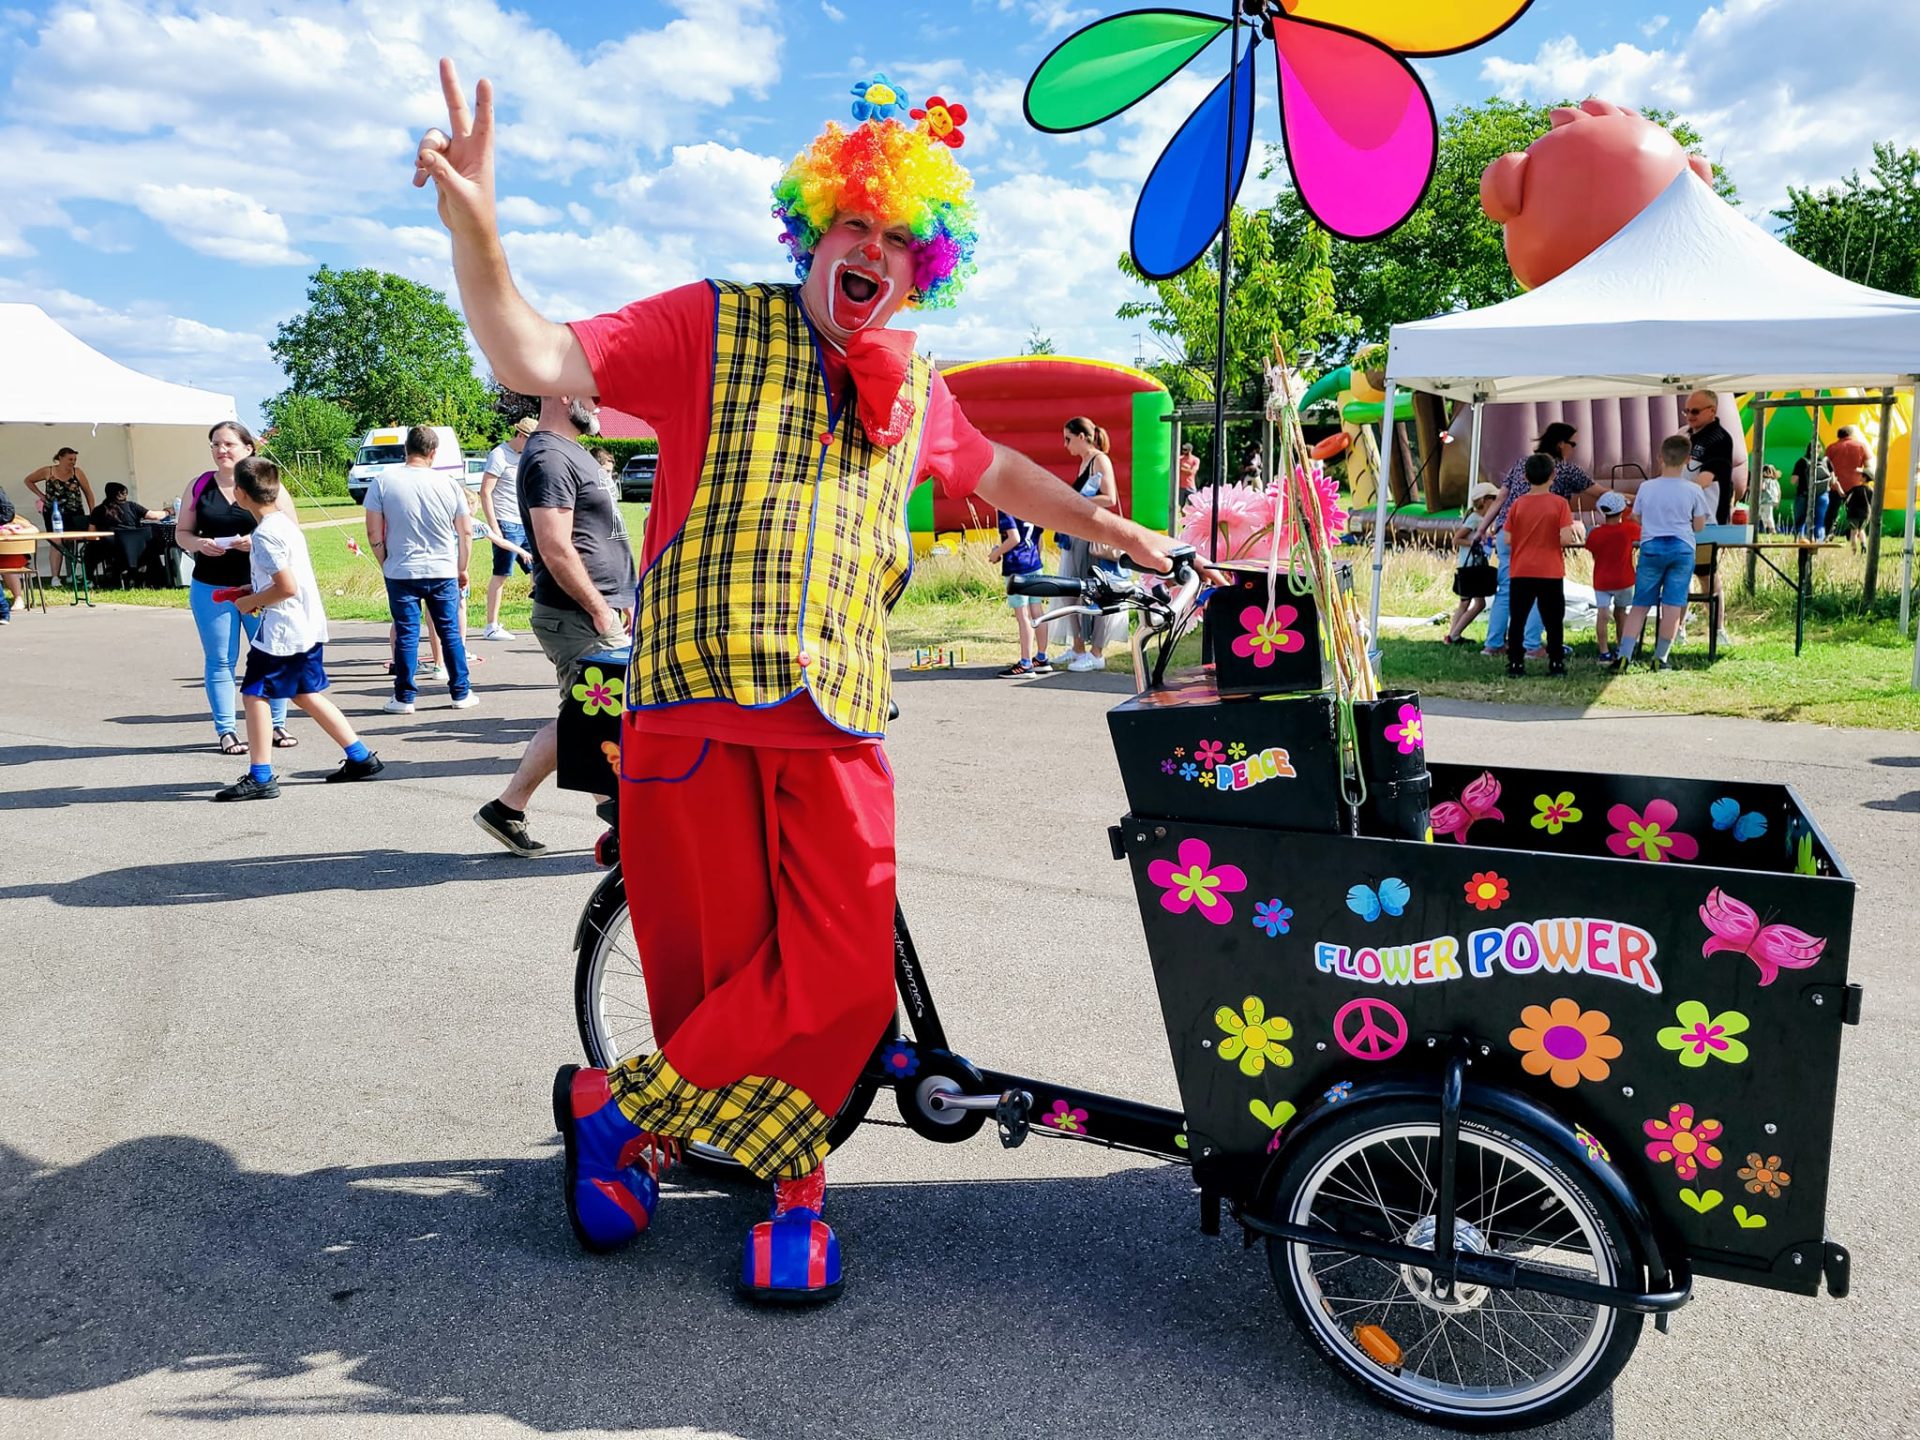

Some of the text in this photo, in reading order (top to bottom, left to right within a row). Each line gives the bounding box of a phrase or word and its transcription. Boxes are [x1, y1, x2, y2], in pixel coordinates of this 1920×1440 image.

[1023, 522, 1035, 549] 7
[1216, 748, 1297, 791] PEACE
[894, 926, 925, 1010] sterdamer
[1315, 918, 1663, 994] FLOWER POWER
